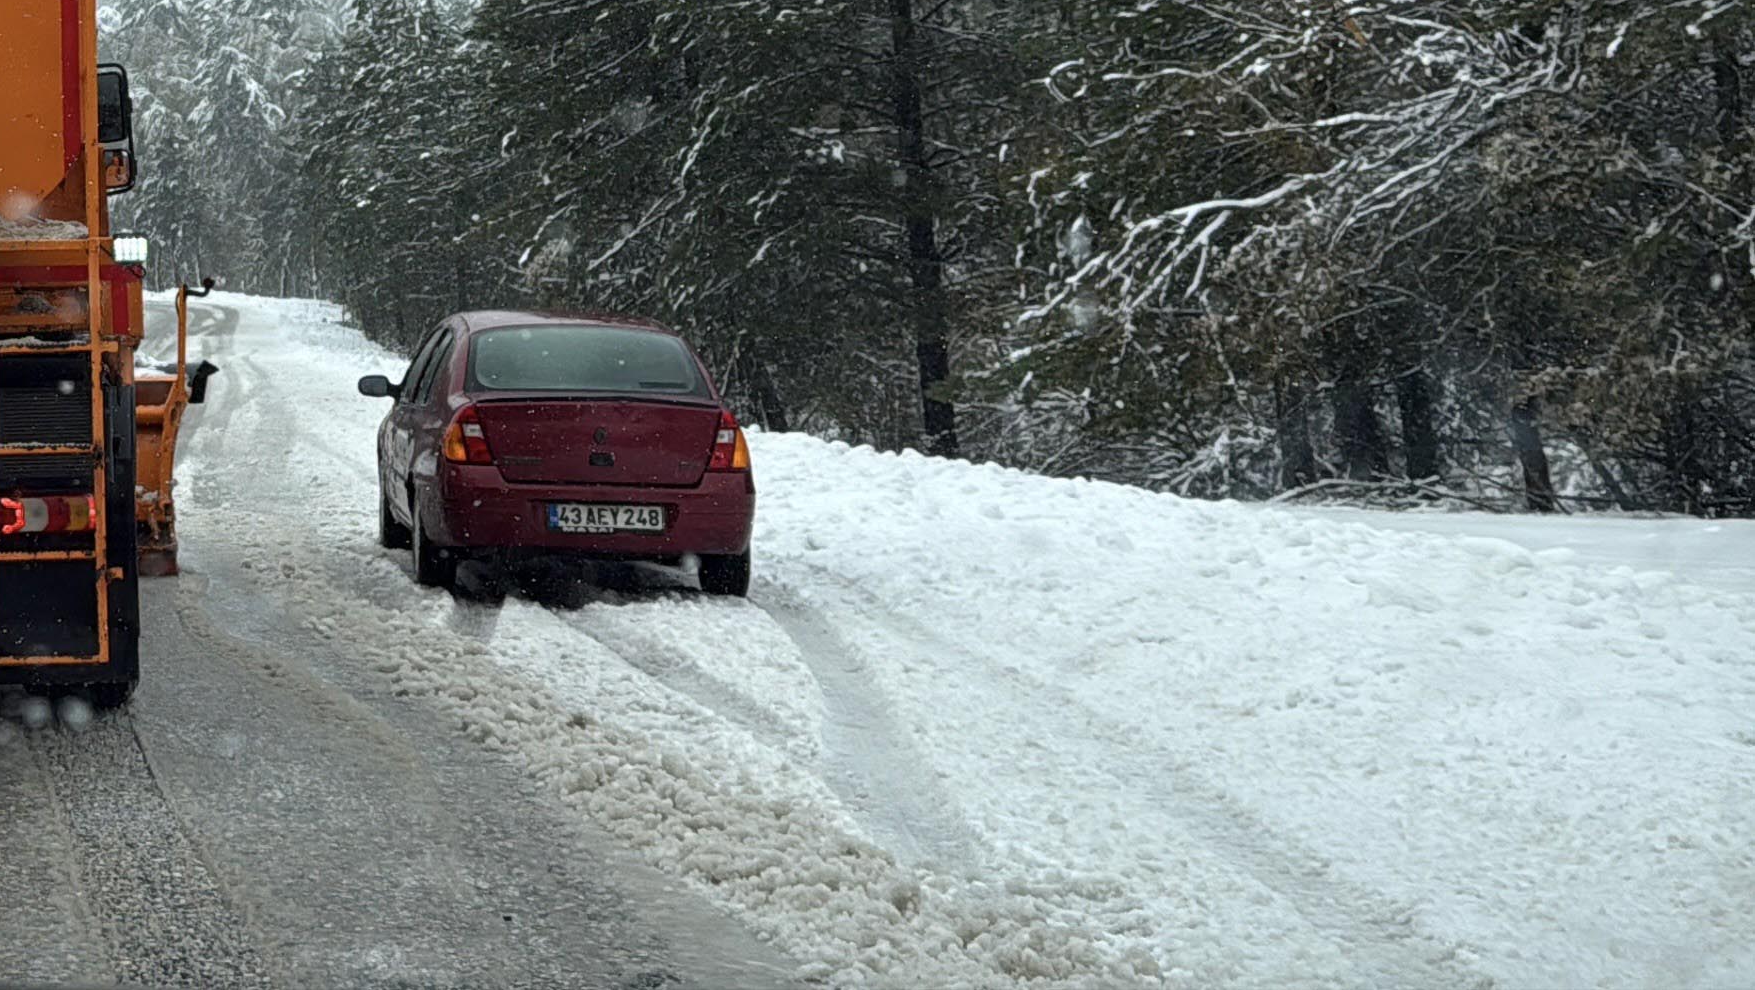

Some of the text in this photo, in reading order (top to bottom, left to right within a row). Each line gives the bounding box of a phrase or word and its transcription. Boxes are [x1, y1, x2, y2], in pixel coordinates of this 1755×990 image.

[559, 506, 660, 527] 43 AEY 248
